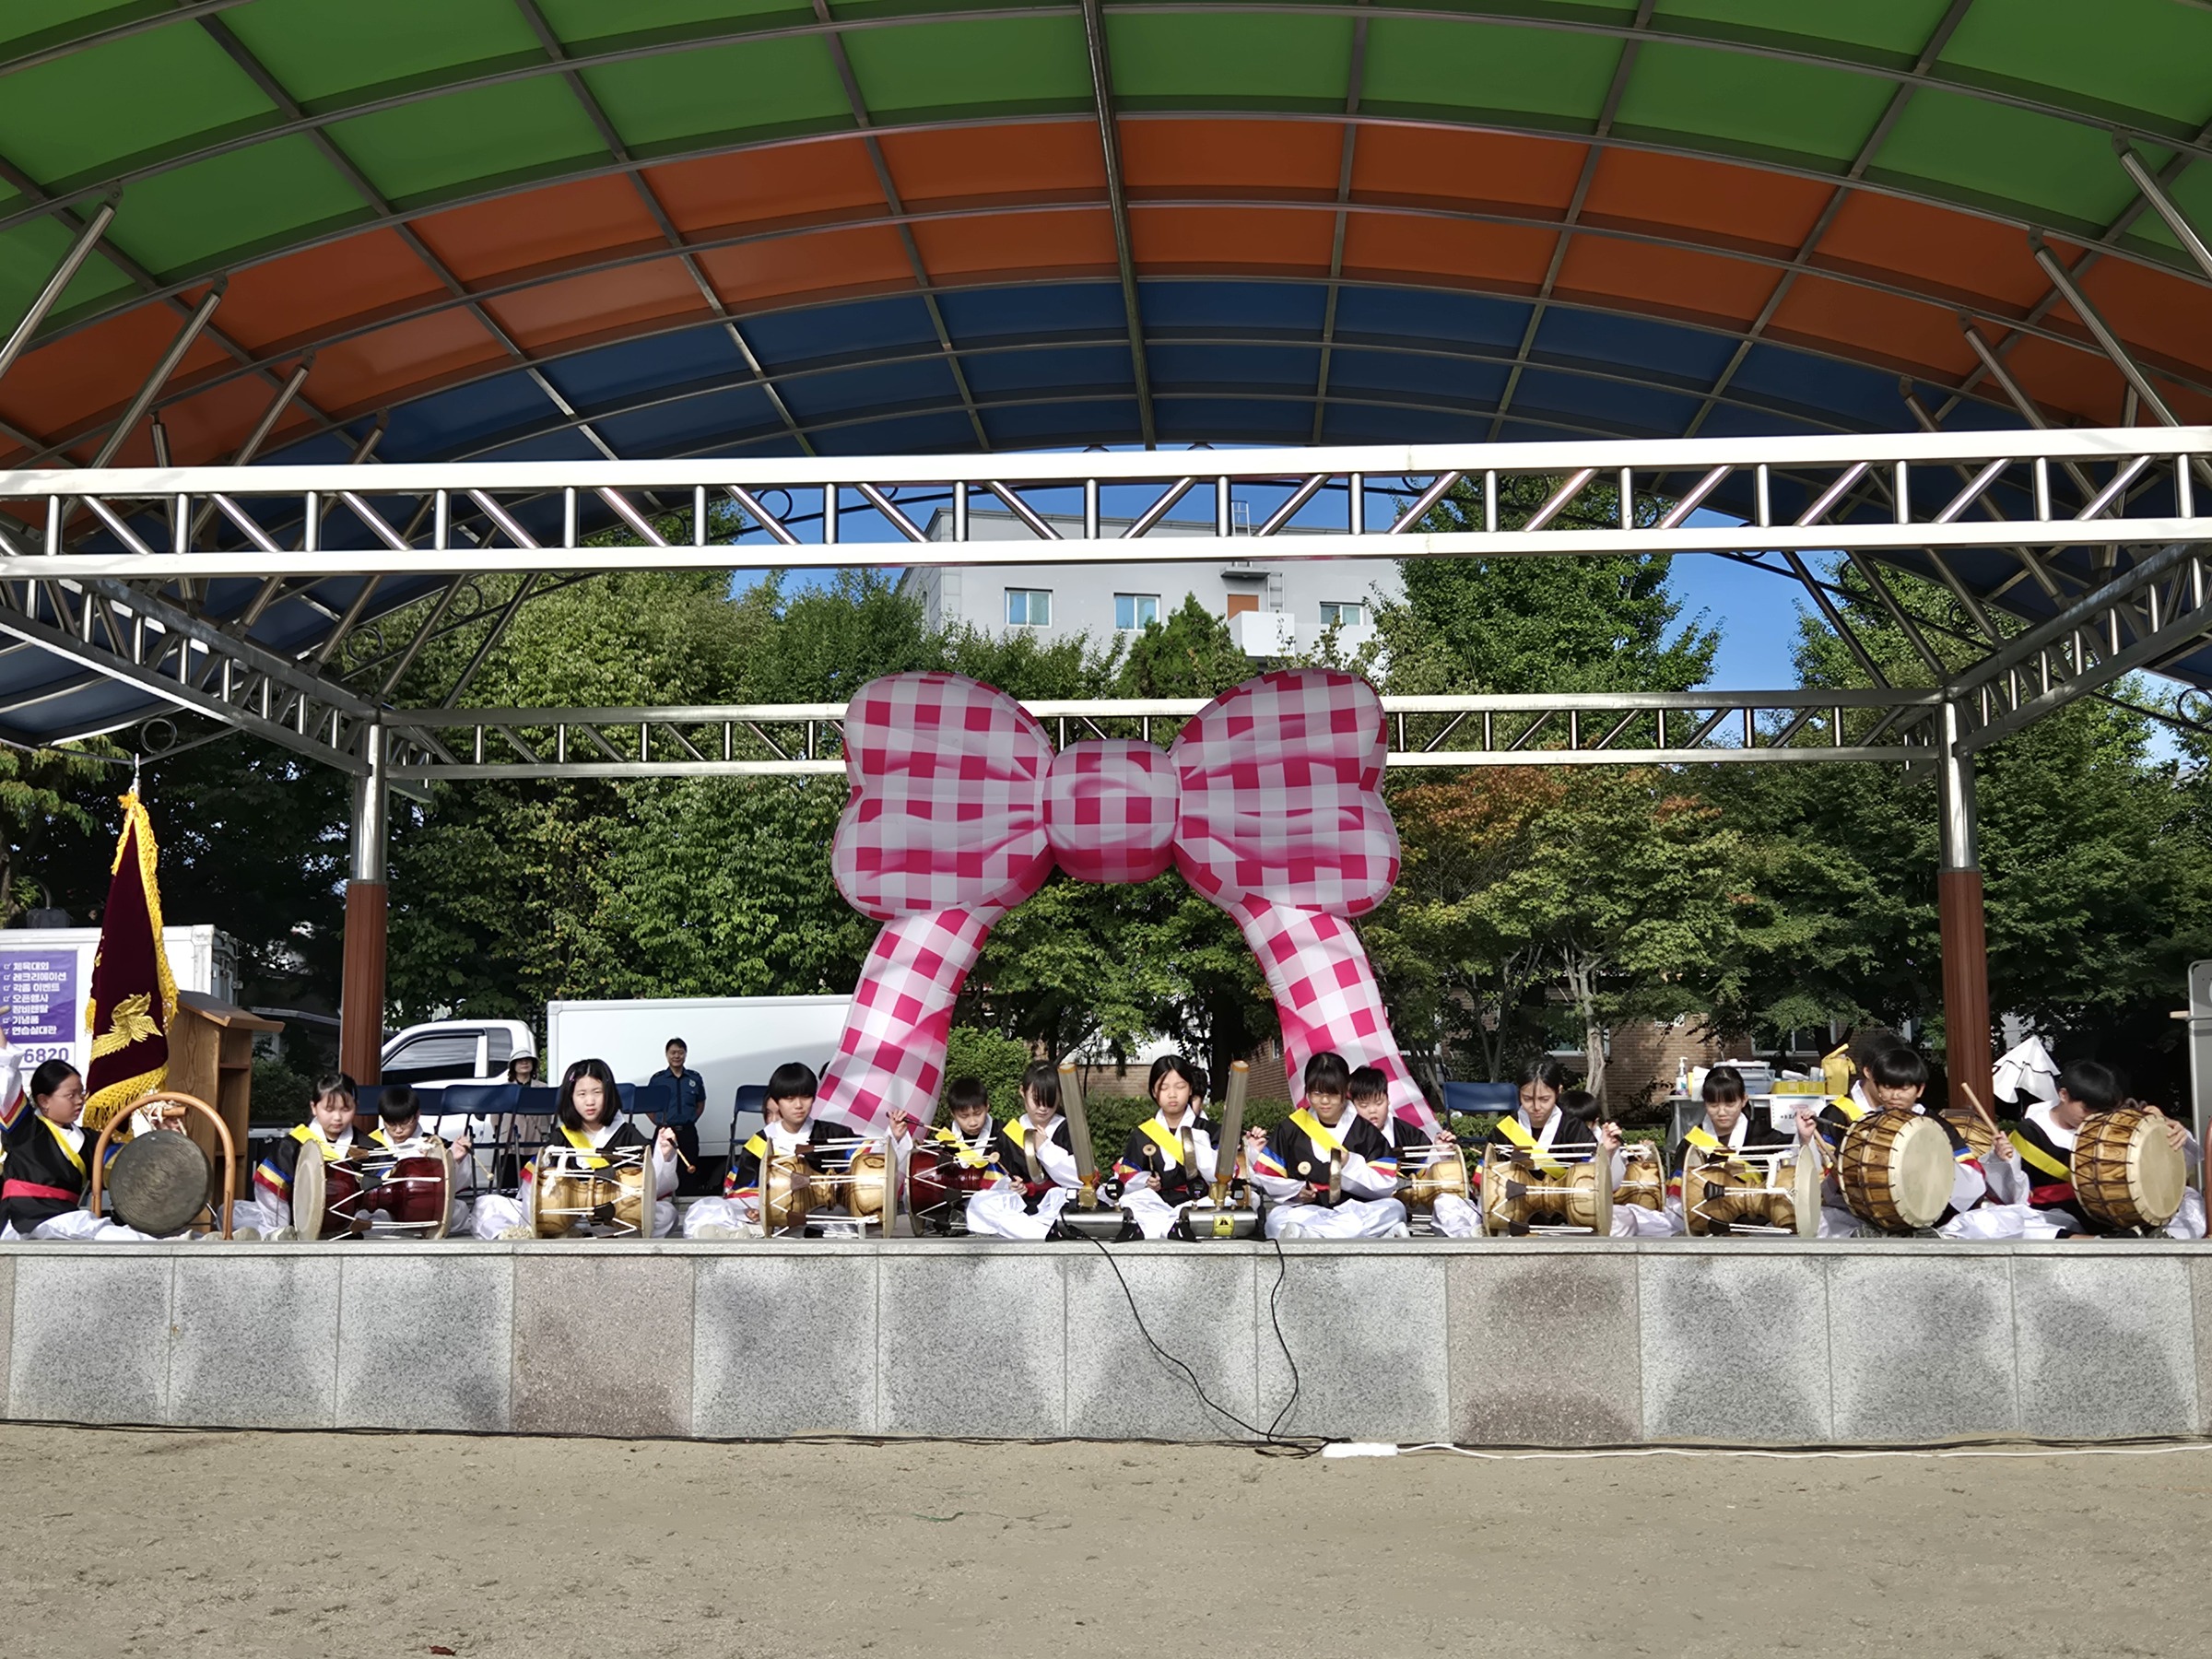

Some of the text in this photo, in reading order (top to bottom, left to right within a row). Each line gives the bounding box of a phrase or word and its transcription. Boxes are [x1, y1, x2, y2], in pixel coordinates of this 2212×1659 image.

[13, 961, 49, 971] 체육대회
[33, 982, 60, 992] 이벤트
[12, 1015, 39, 1024] 기념품
